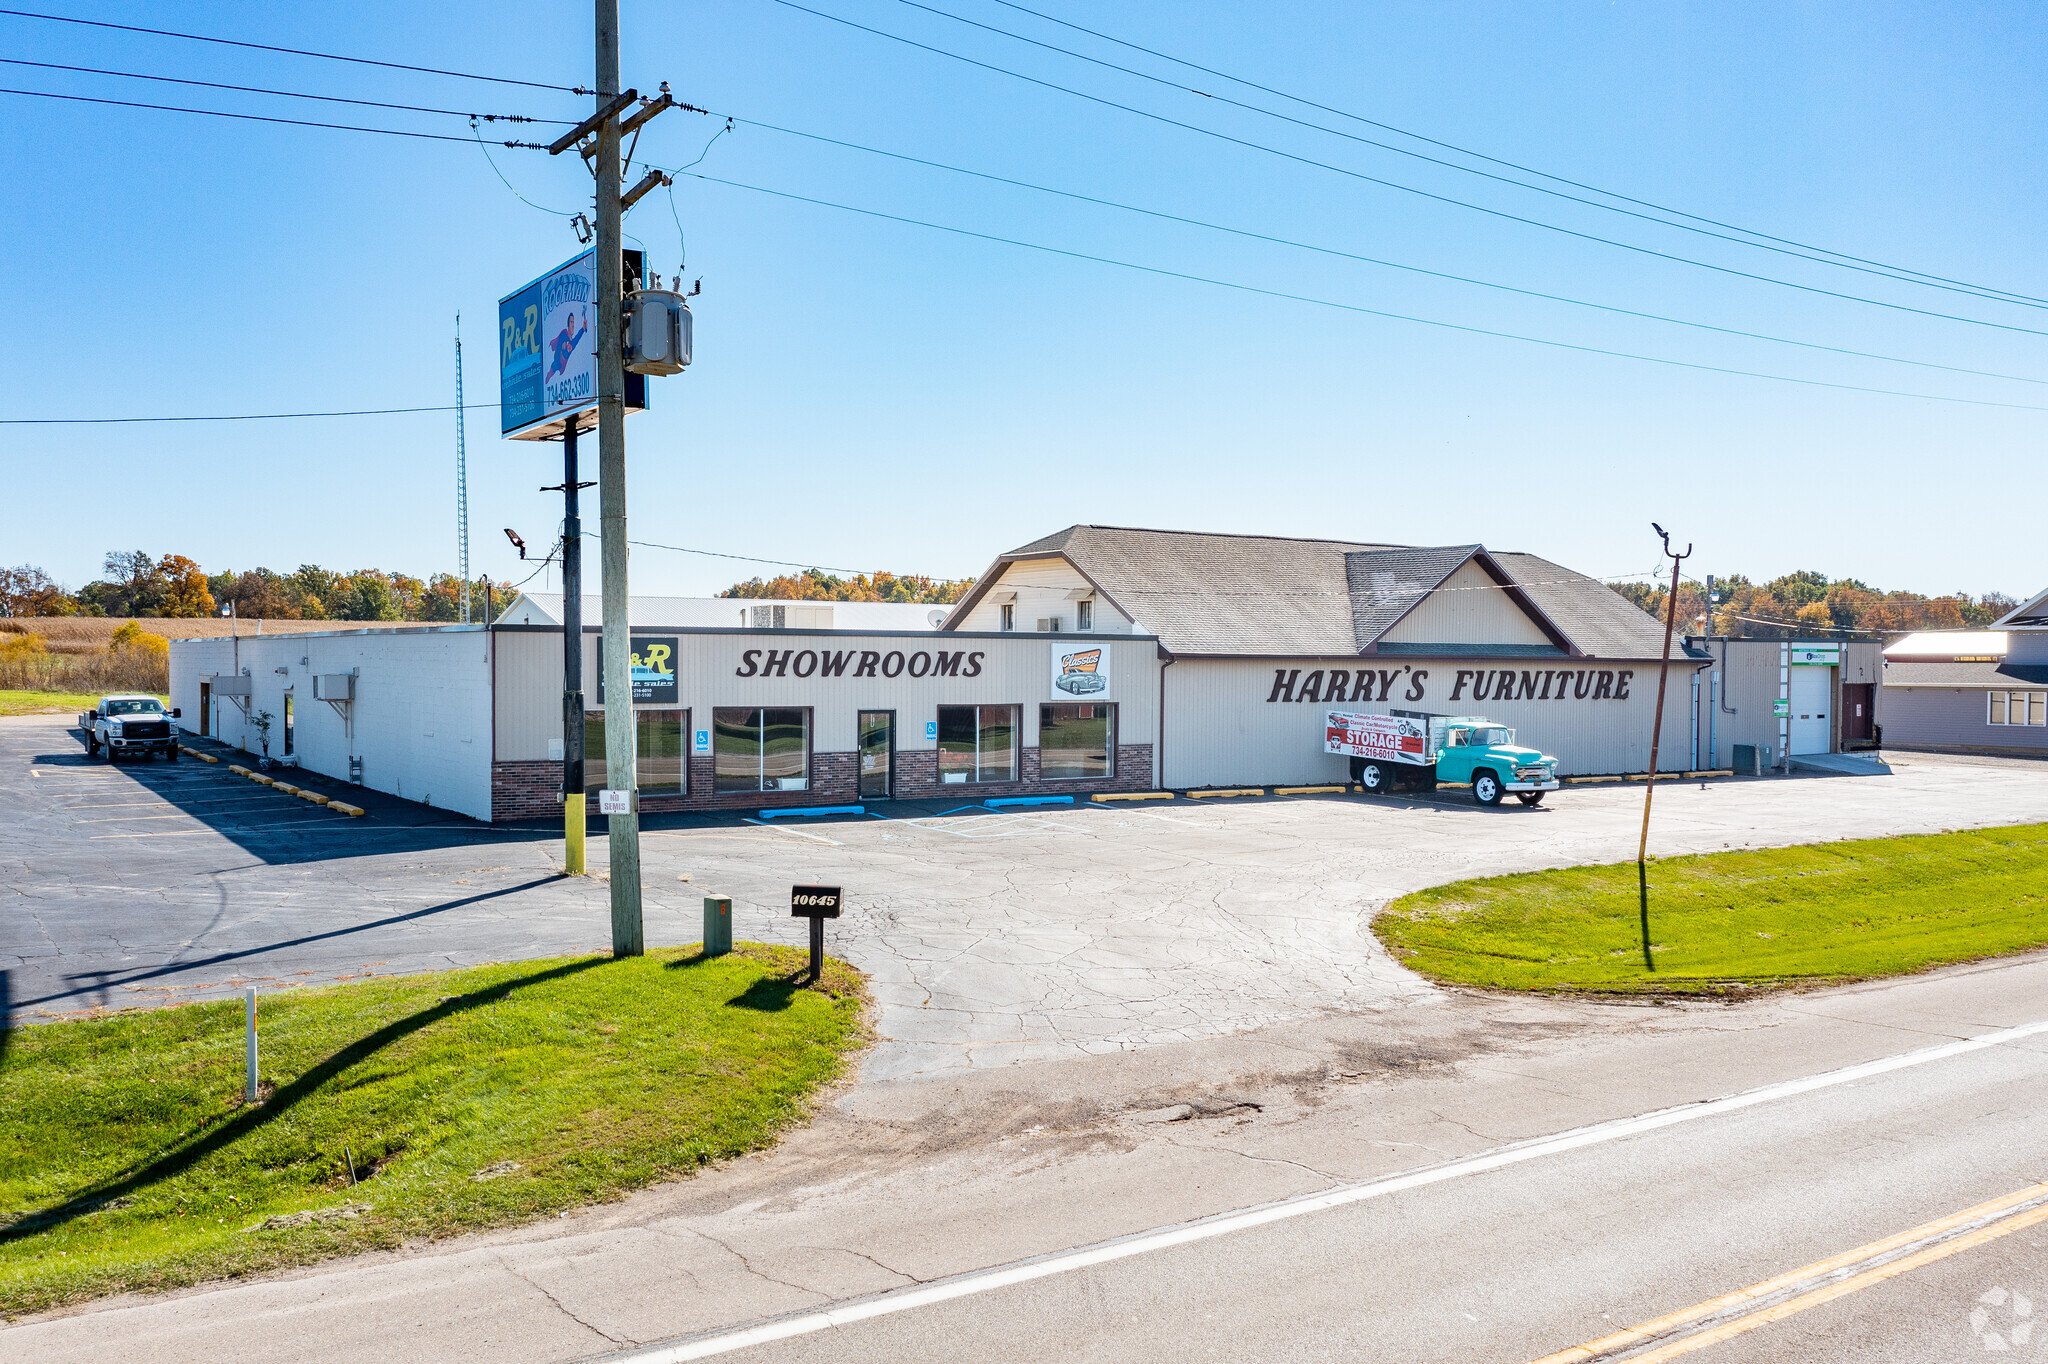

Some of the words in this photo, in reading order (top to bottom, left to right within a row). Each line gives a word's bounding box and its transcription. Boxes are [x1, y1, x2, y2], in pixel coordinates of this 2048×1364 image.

[502, 304, 540, 368] R&R
[523, 366, 541, 380] sales
[547, 371, 590, 408] 734-662-3300
[630, 644, 674, 674] &R
[736, 649, 985, 678] SHOWROOMS
[1062, 653, 1100, 668] Classics
[1266, 665, 1428, 703] HARRY'S
[1449, 669, 1634, 701] FURNITURE
[1346, 730, 1403, 750] STORAGE
[1352, 746, 1395, 760] 734-216-6010
[604, 802, 626, 811] SEMIS
[610, 794, 620, 802] NO
[792, 894, 837, 906] 10645
